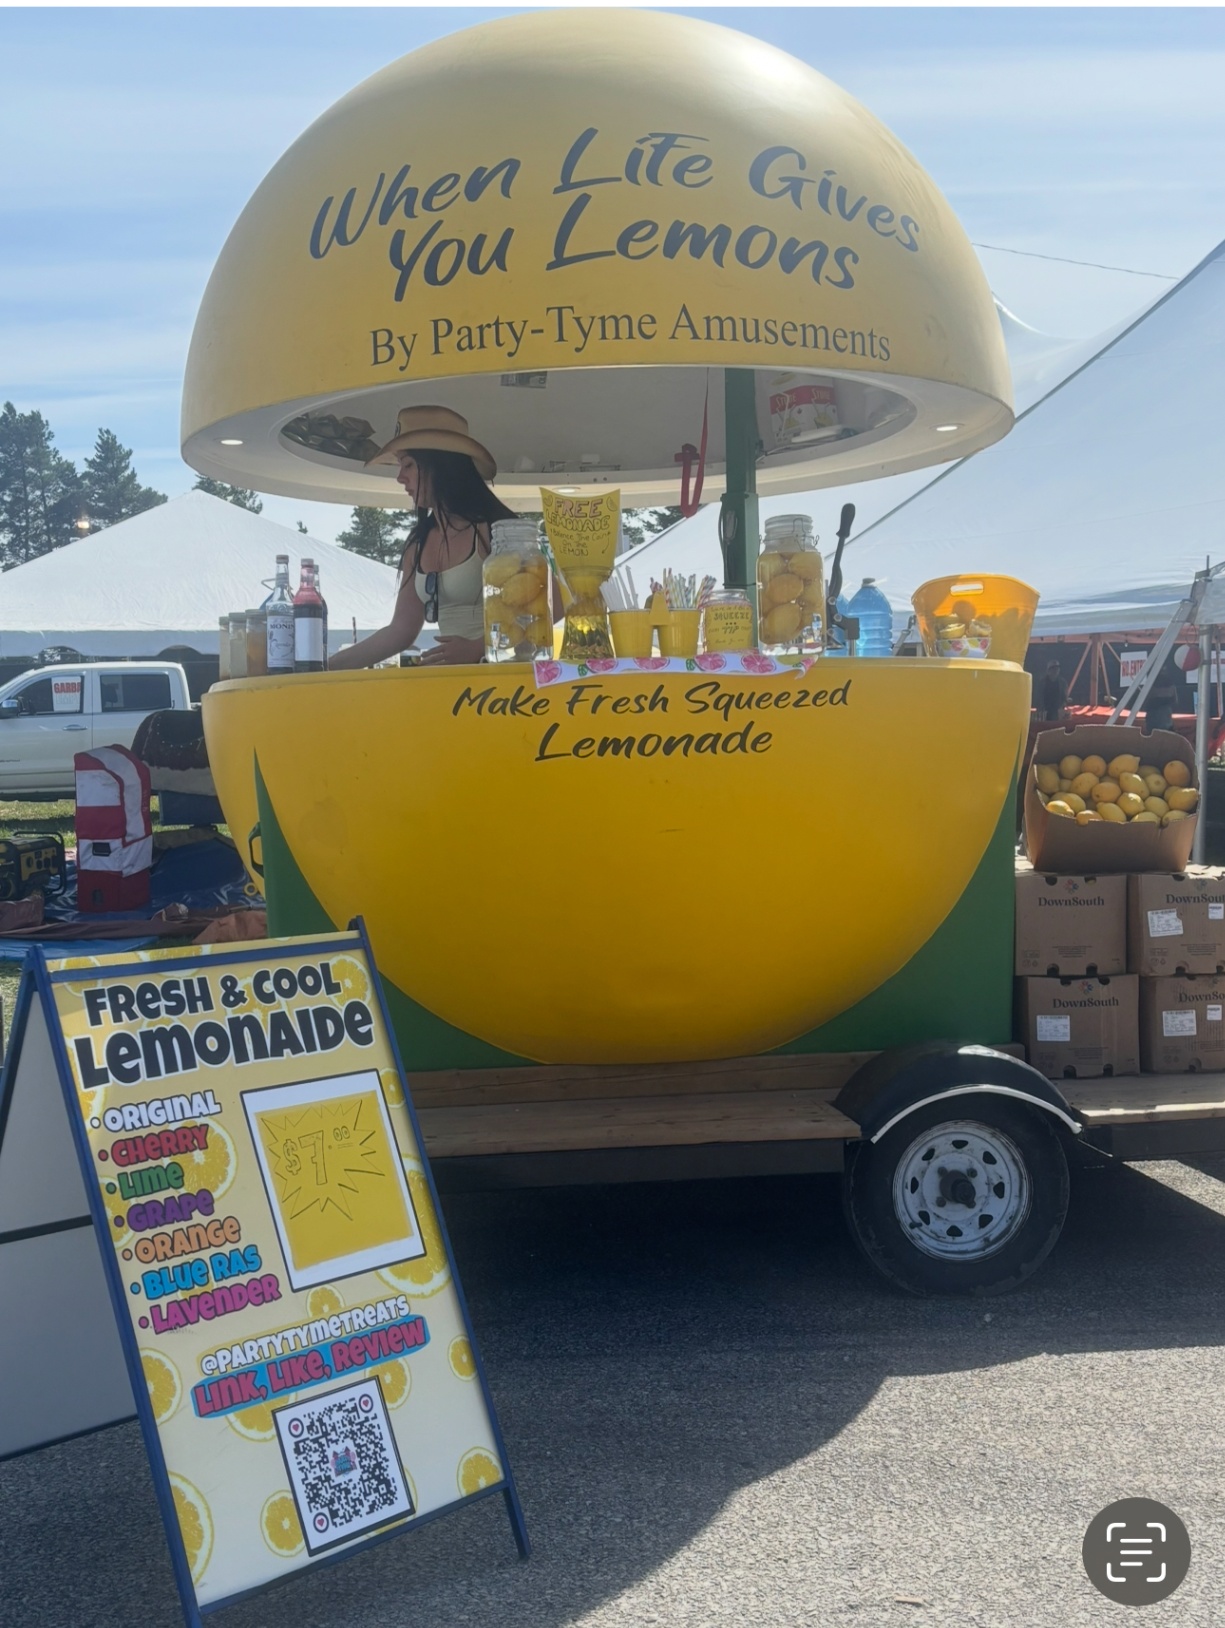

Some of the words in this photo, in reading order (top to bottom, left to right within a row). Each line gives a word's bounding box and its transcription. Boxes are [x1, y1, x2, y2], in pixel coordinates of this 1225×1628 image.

[310, 158, 521, 260] When
[553, 127, 715, 194] Life
[749, 145, 920, 253] Gives
[390, 220, 515, 302] You
[545, 193, 860, 290] Lemons
[370, 327, 419, 372] By
[431, 304, 658, 357] Party-Tyme
[668, 303, 892, 361] Amusements
[546, 508, 611, 532] LEMONADE
[554, 497, 604, 518] FREE
[452, 686, 550, 718] Make
[566, 684, 669, 716] Fresh
[685, 679, 852, 721] Squeezed
[535, 722, 773, 762] Lemonade
[1038, 896, 1105, 907] DownSouth
[220, 974, 249, 1008] &
[253, 962, 342, 1002] COOL
[1052, 997, 1119, 1009] DownSouth
[211, 1244, 262, 1282] RAS
